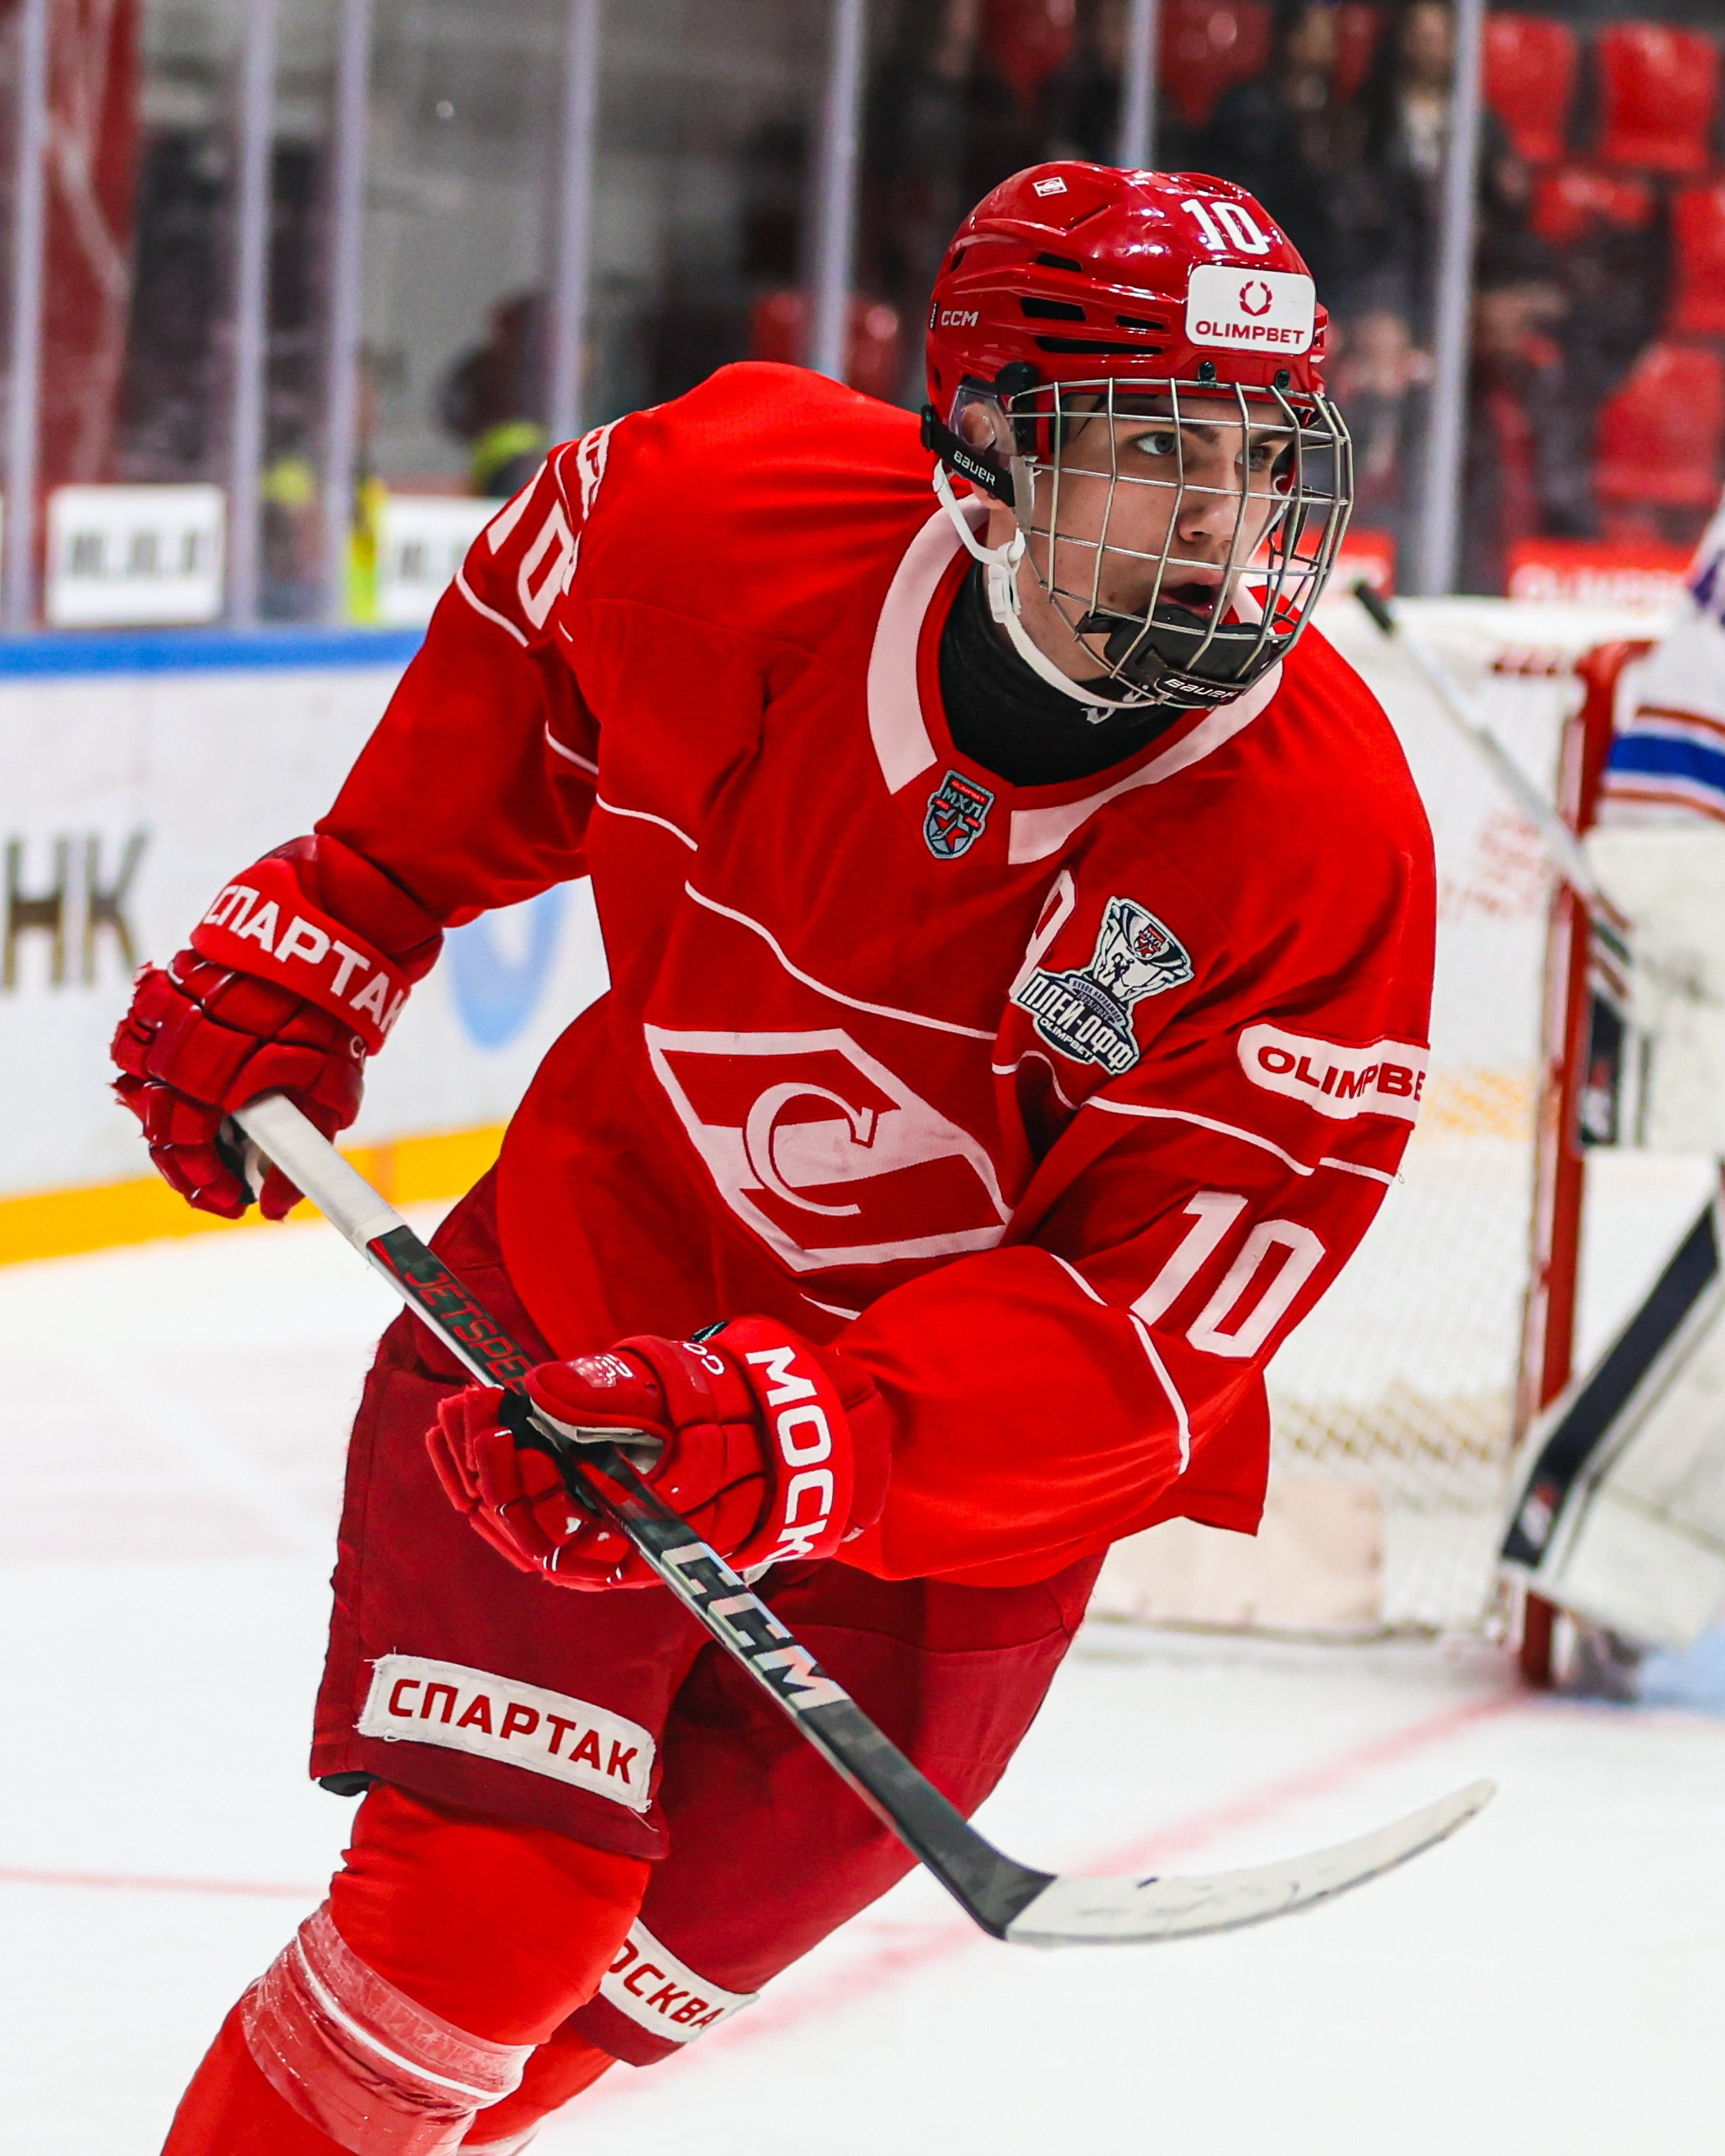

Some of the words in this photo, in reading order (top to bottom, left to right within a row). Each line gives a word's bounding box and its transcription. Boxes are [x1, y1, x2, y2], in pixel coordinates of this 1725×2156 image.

[1180, 198, 1271, 256] 10
[941, 310, 979, 327] CCM
[1195, 320, 1304, 344] OLIMPBET
[941, 786, 983, 820] МХЛ
[1019, 975, 1134, 1069] ПЛЕЙ-ОФФ
[1039, 1017, 1092, 1058] OLIMPBET
[1129, 1190, 1327, 1359] 10
[660, 1541, 851, 1713] CCM
[388, 1678, 638, 1785] СПАРТАК
